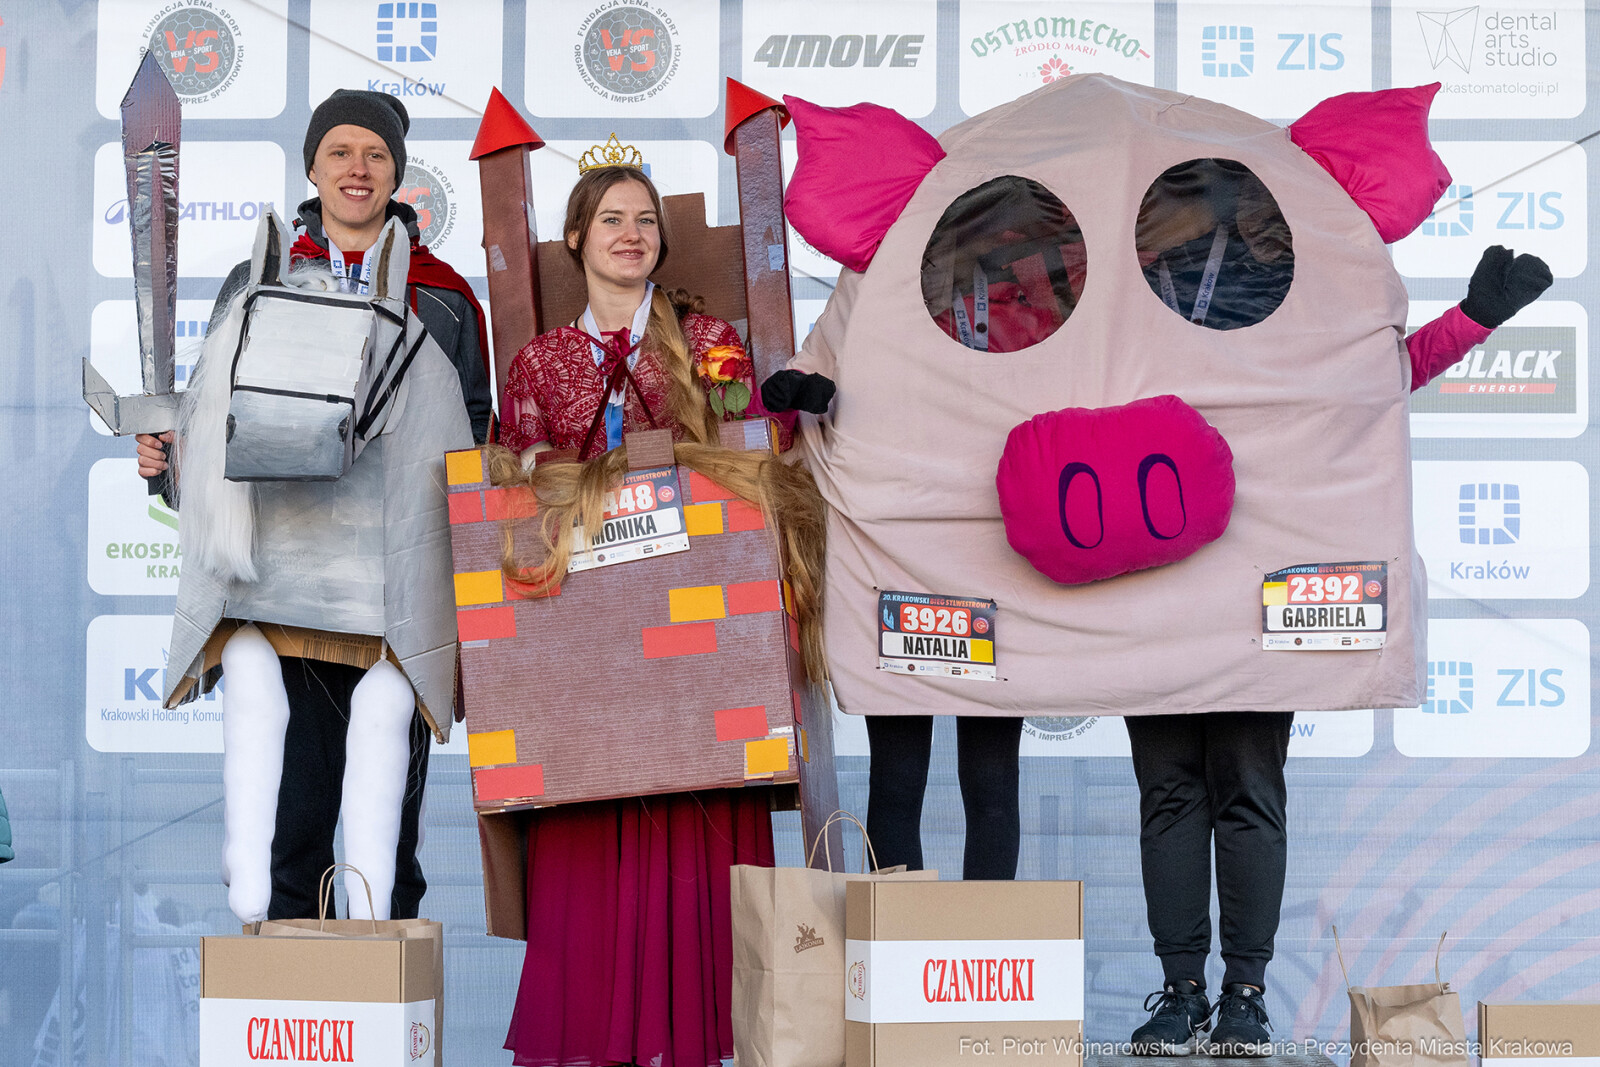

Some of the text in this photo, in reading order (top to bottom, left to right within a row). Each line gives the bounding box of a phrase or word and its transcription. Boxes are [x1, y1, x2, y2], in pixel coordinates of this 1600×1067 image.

[142, 1, 184, 39] FUNDACJA
[219, 9, 242, 37] SPORT
[577, 0, 620, 37] FUNDACJA
[655, 8, 679, 36] SPORT
[1485, 11, 1557, 31] dental
[193, 45, 213, 55] SPORT
[600, 29, 656, 72] VS
[629, 43, 650, 54] SPORT
[970, 16, 1141, 58] OSTROMECKO
[1064, 43, 1098, 57] MARII
[1485, 31, 1529, 49] arts
[753, 34, 925, 68] 4MOVE
[1277, 33, 1345, 71] ZIS
[1485, 47, 1557, 67] studio
[211, 45, 245, 96] SPORTOWYCH
[574, 44, 681, 103] ORGANIZACJA IMPREZ SPORTOWYCH
[367, 77, 446, 97] Kraków
[1439, 82, 1559, 96] ukastomatologii.pl
[432, 166, 455, 194] SPORT
[1496, 191, 1565, 230] ZIS
[429, 202, 457, 253] PORTOWYCH
[1445, 350, 1562, 379] BLACK
[1468, 384, 1527, 393] ENERGY
[625, 469, 673, 484] SYLWESTROWY
[603, 484, 654, 516] 448
[591, 514, 658, 546] MONIKA
[1335, 564, 1382, 573] SYLWESTROWY
[1450, 560, 1530, 579] Kraków
[892, 594, 930, 604] KRAKOWSKI
[945, 600, 992, 609] SYLWESTROWY
[1290, 575, 1360, 602] 2392
[903, 606, 969, 635] 3926
[1282, 606, 1366, 628] GABRIELA
[903, 635, 969, 659] NATALIA
[1496, 668, 1566, 707] ZIS
[101, 708, 150, 721] Krakowski
[152, 709, 189, 724] Holding
[1039, 732, 1075, 742] IMPREZ
[923, 958, 1035, 1003] CZANIECKI
[247, 1017, 354, 1063] CZANIECKI
